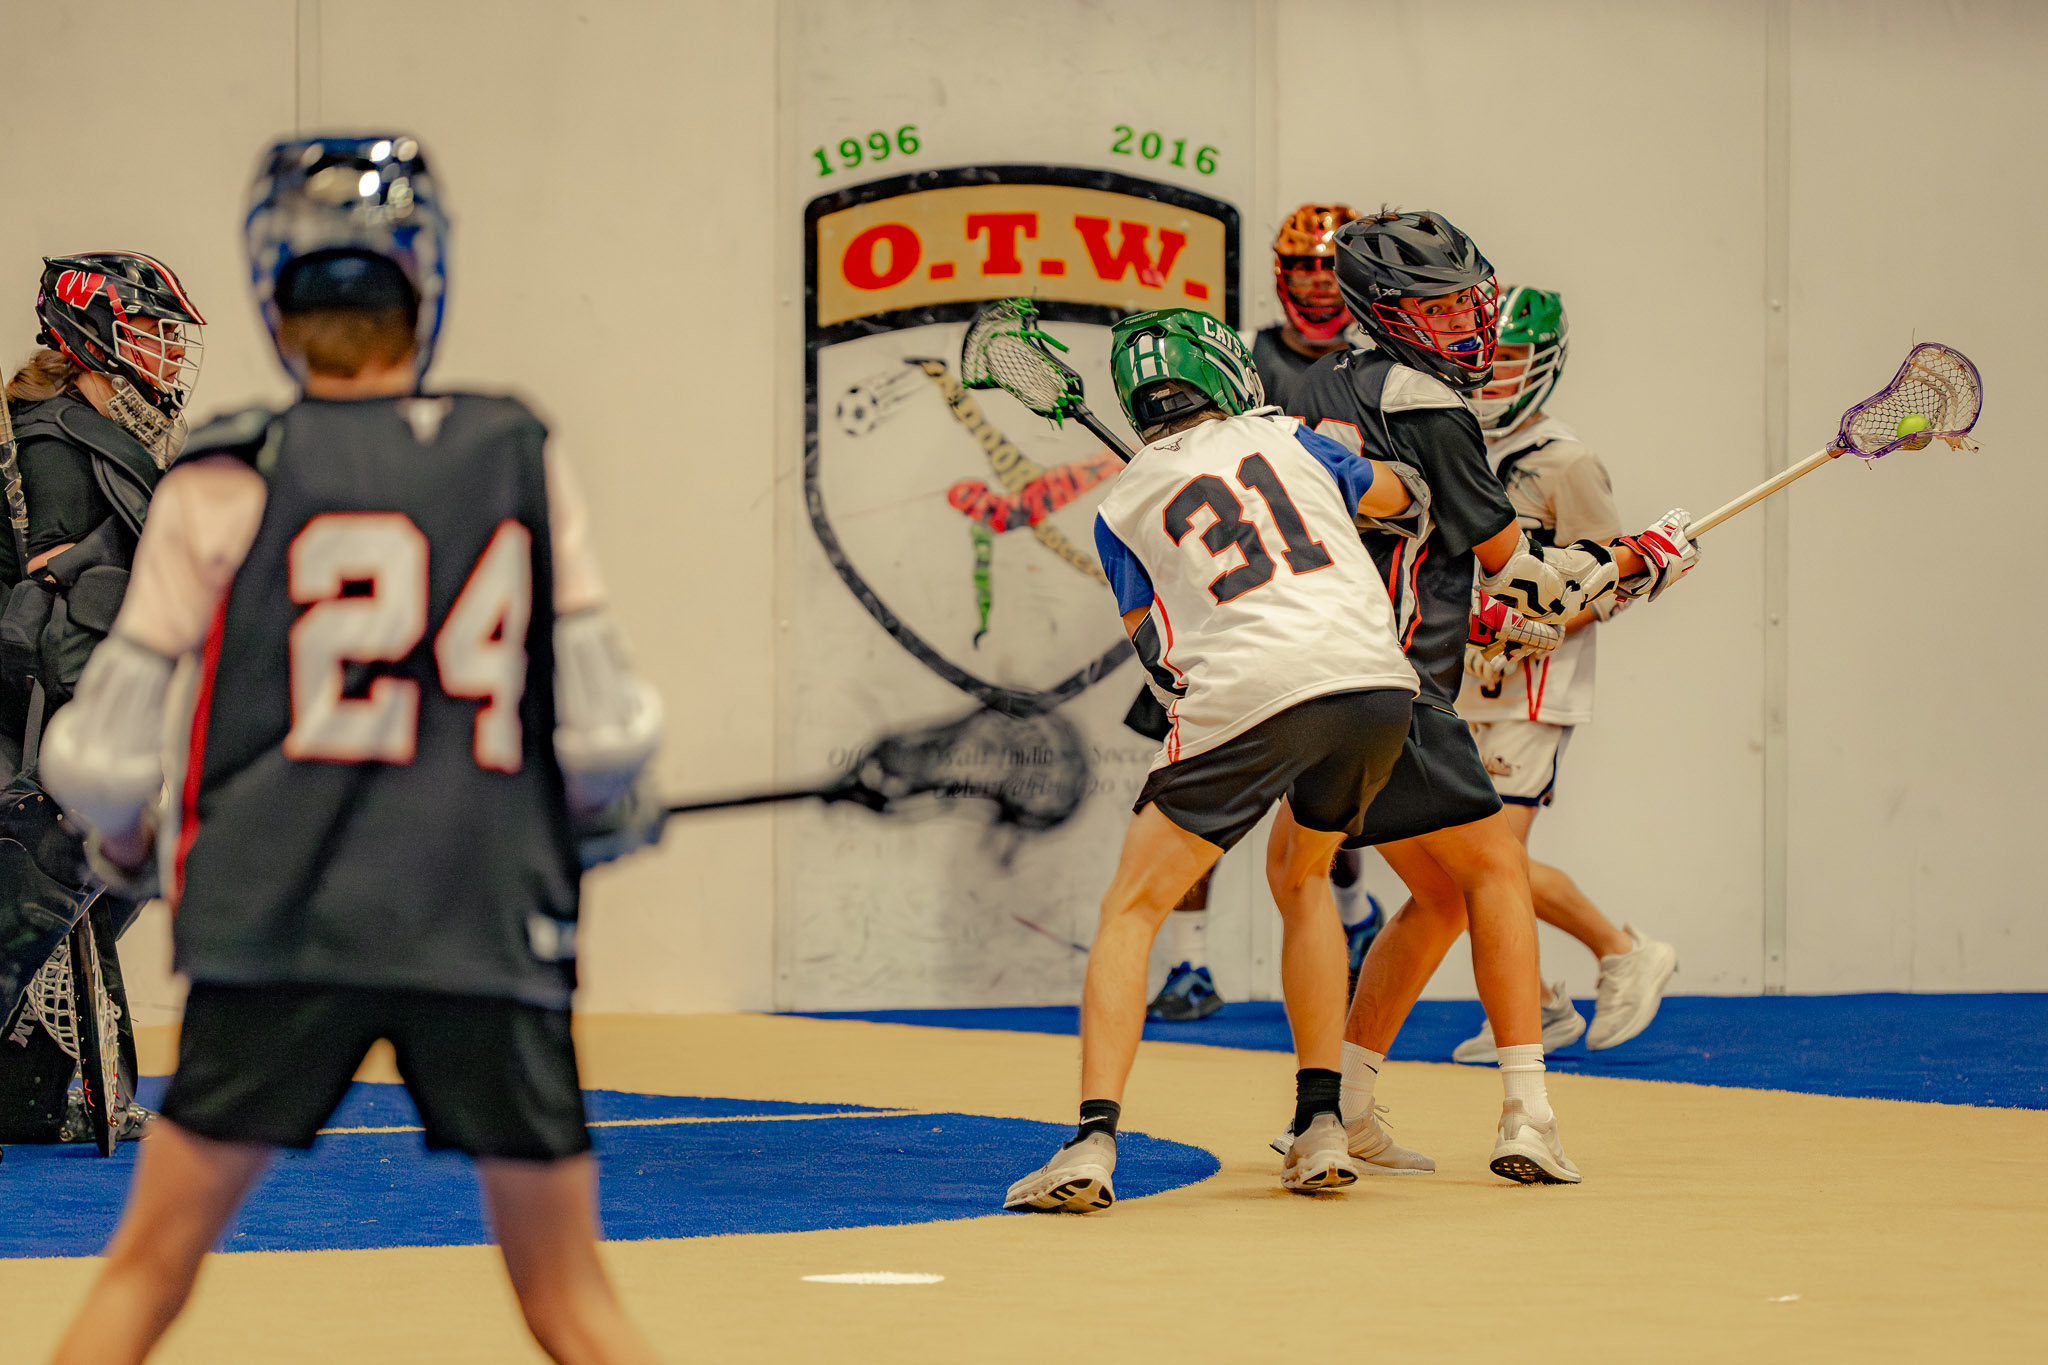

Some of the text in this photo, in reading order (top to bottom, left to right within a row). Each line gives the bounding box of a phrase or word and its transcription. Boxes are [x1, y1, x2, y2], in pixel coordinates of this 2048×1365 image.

[813, 124, 920, 176] 1996
[1111, 125, 1219, 175] 2016
[841, 211, 1210, 300] O.T.W.
[54, 269, 106, 311] W
[1125, 311, 1158, 325] cascade
[1202, 316, 1242, 359] CATS
[1163, 452, 1335, 606] 31
[283, 512, 532, 775] 24
